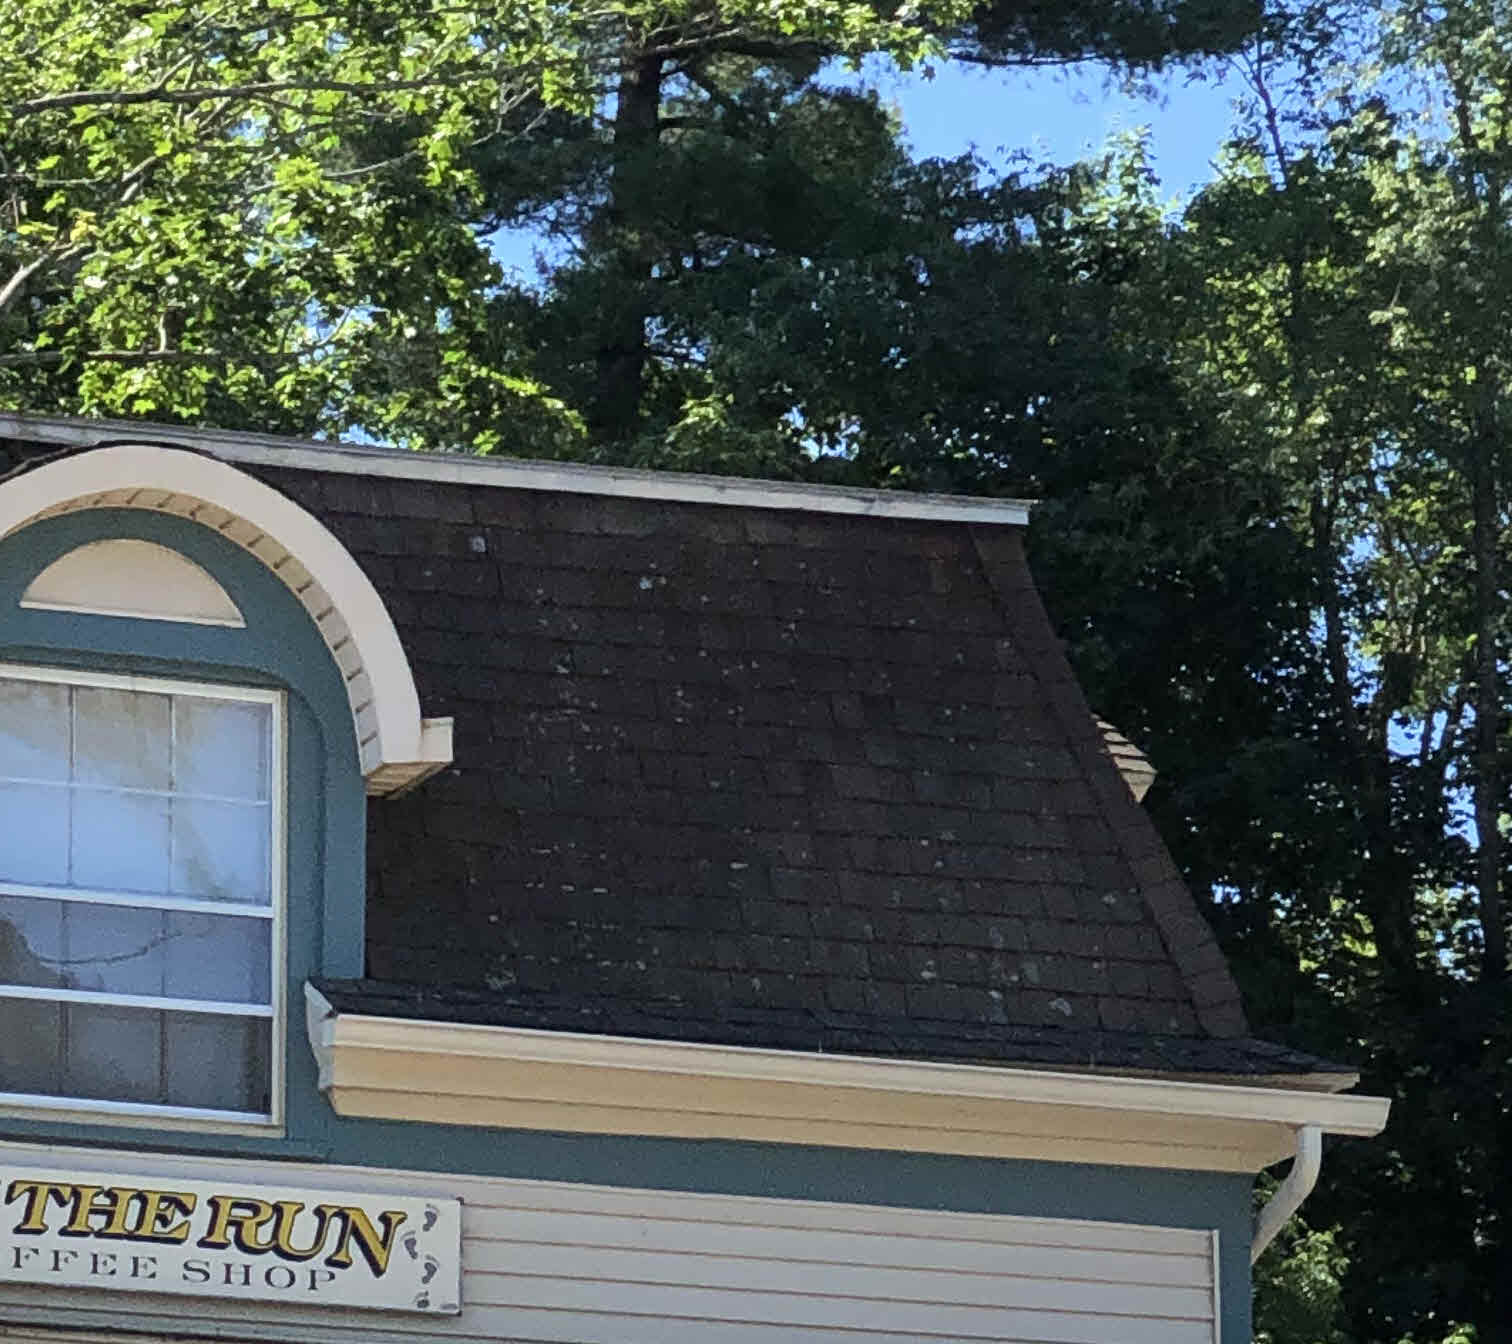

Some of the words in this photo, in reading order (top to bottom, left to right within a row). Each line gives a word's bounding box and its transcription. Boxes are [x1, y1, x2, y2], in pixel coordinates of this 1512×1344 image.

[4, 1178, 198, 1245] THE
[197, 1195, 408, 1279] RUN
[182, 1259, 337, 1291] SHOP
